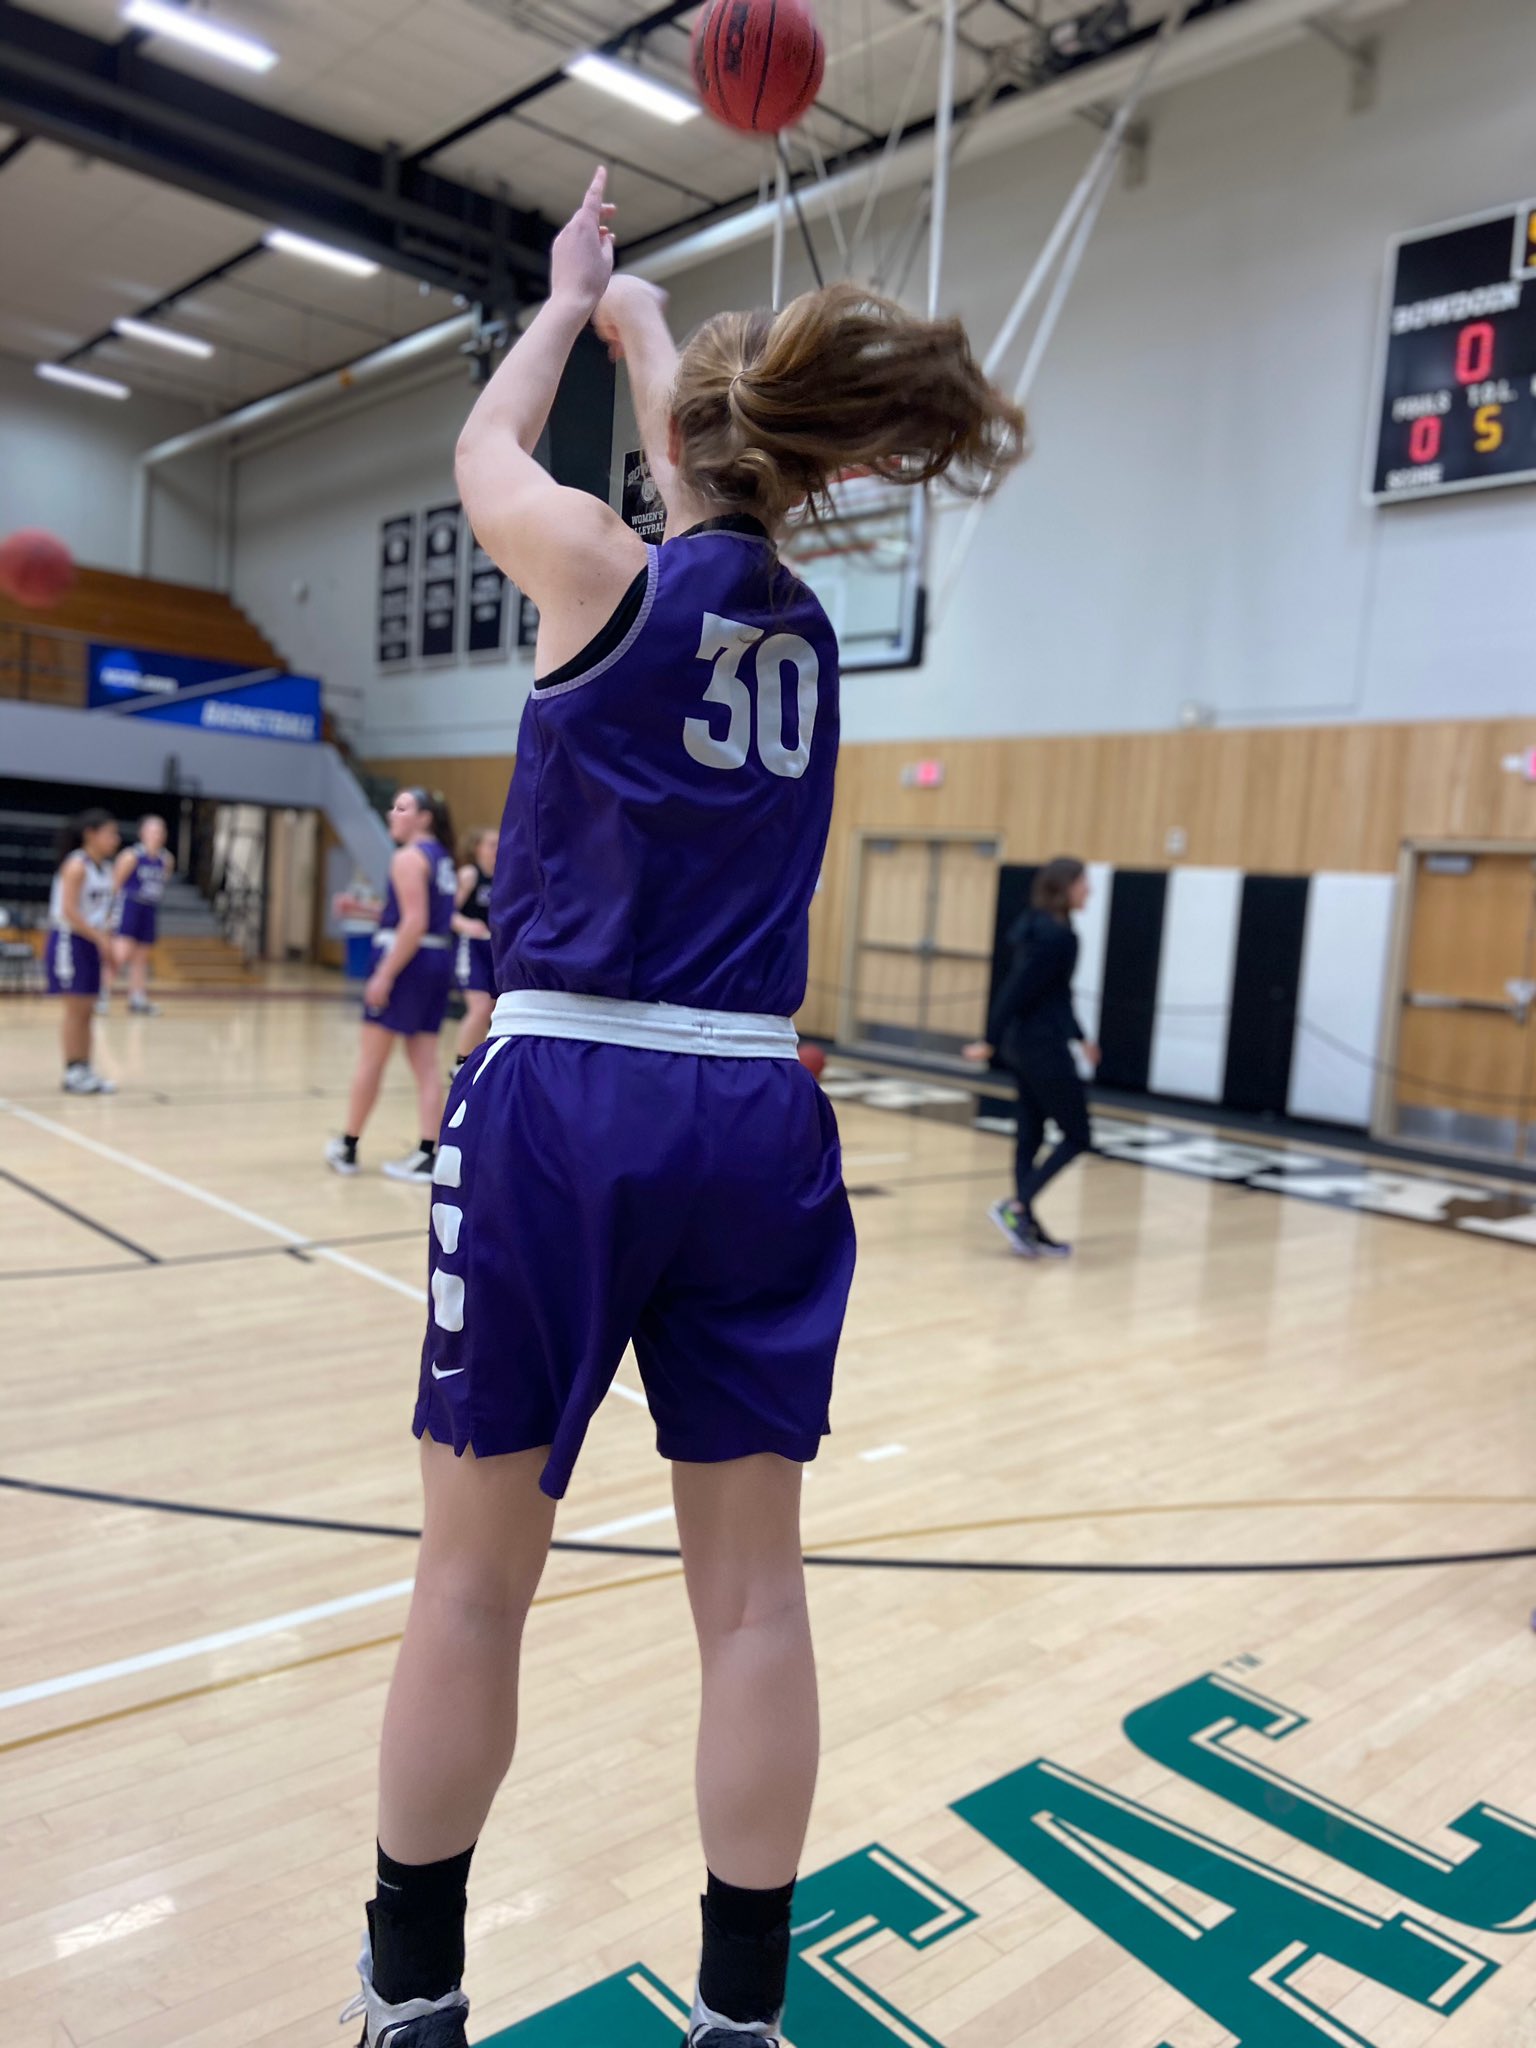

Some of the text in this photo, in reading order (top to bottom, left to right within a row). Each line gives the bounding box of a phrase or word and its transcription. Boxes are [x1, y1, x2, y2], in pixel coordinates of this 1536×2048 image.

[1456, 322, 1495, 384] 0
[1409, 404, 1503, 463] 0 5
[632, 510, 664, 525] WOMEN'S
[682, 611, 819, 779] 30
